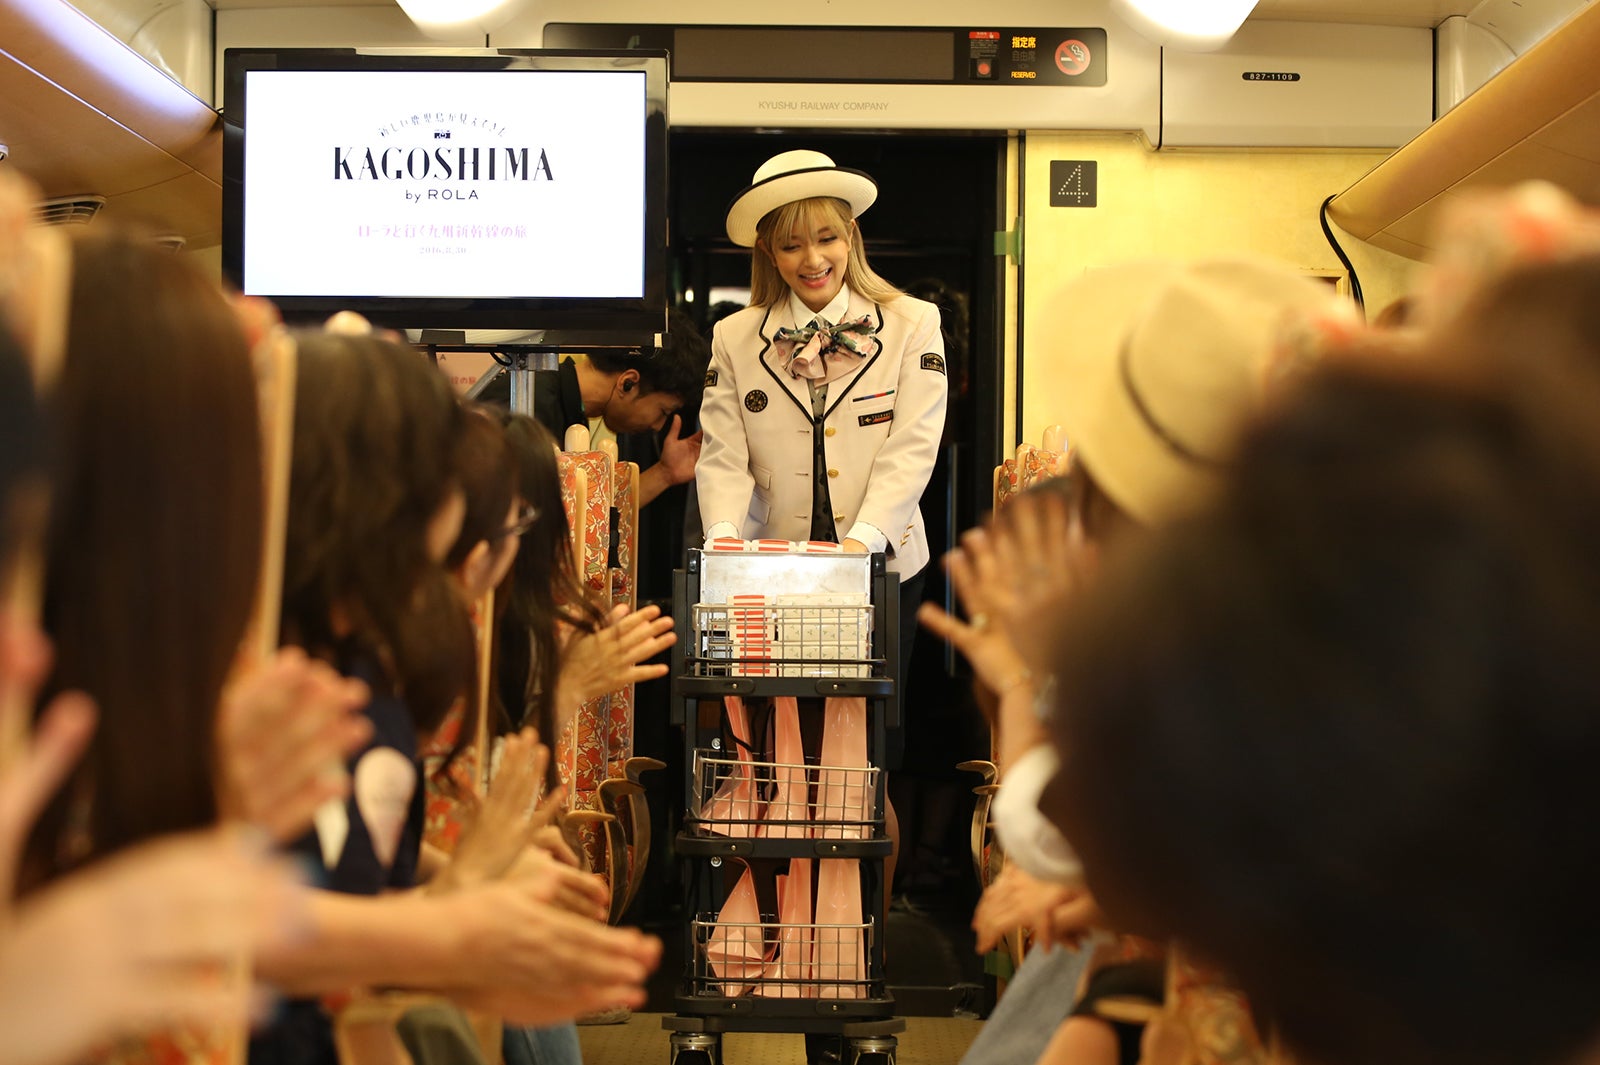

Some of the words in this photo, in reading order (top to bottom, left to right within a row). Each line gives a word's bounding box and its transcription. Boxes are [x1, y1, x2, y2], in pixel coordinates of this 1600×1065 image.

[1011, 36, 1037, 49] 指定席
[1010, 71, 1037, 79] RESERVED
[1249, 73, 1293, 81] 827-1109
[758, 100, 798, 110] KYUSHU
[800, 101, 841, 111] RAILWAY
[842, 102, 889, 111] COMPANY
[333, 147, 555, 181] KAGOSHIMA
[1057, 164, 1089, 204] 4
[405, 189, 421, 203] by
[428, 189, 479, 201] ROLA
[357, 224, 528, 239] ローラと行く九州新幹線の旅
